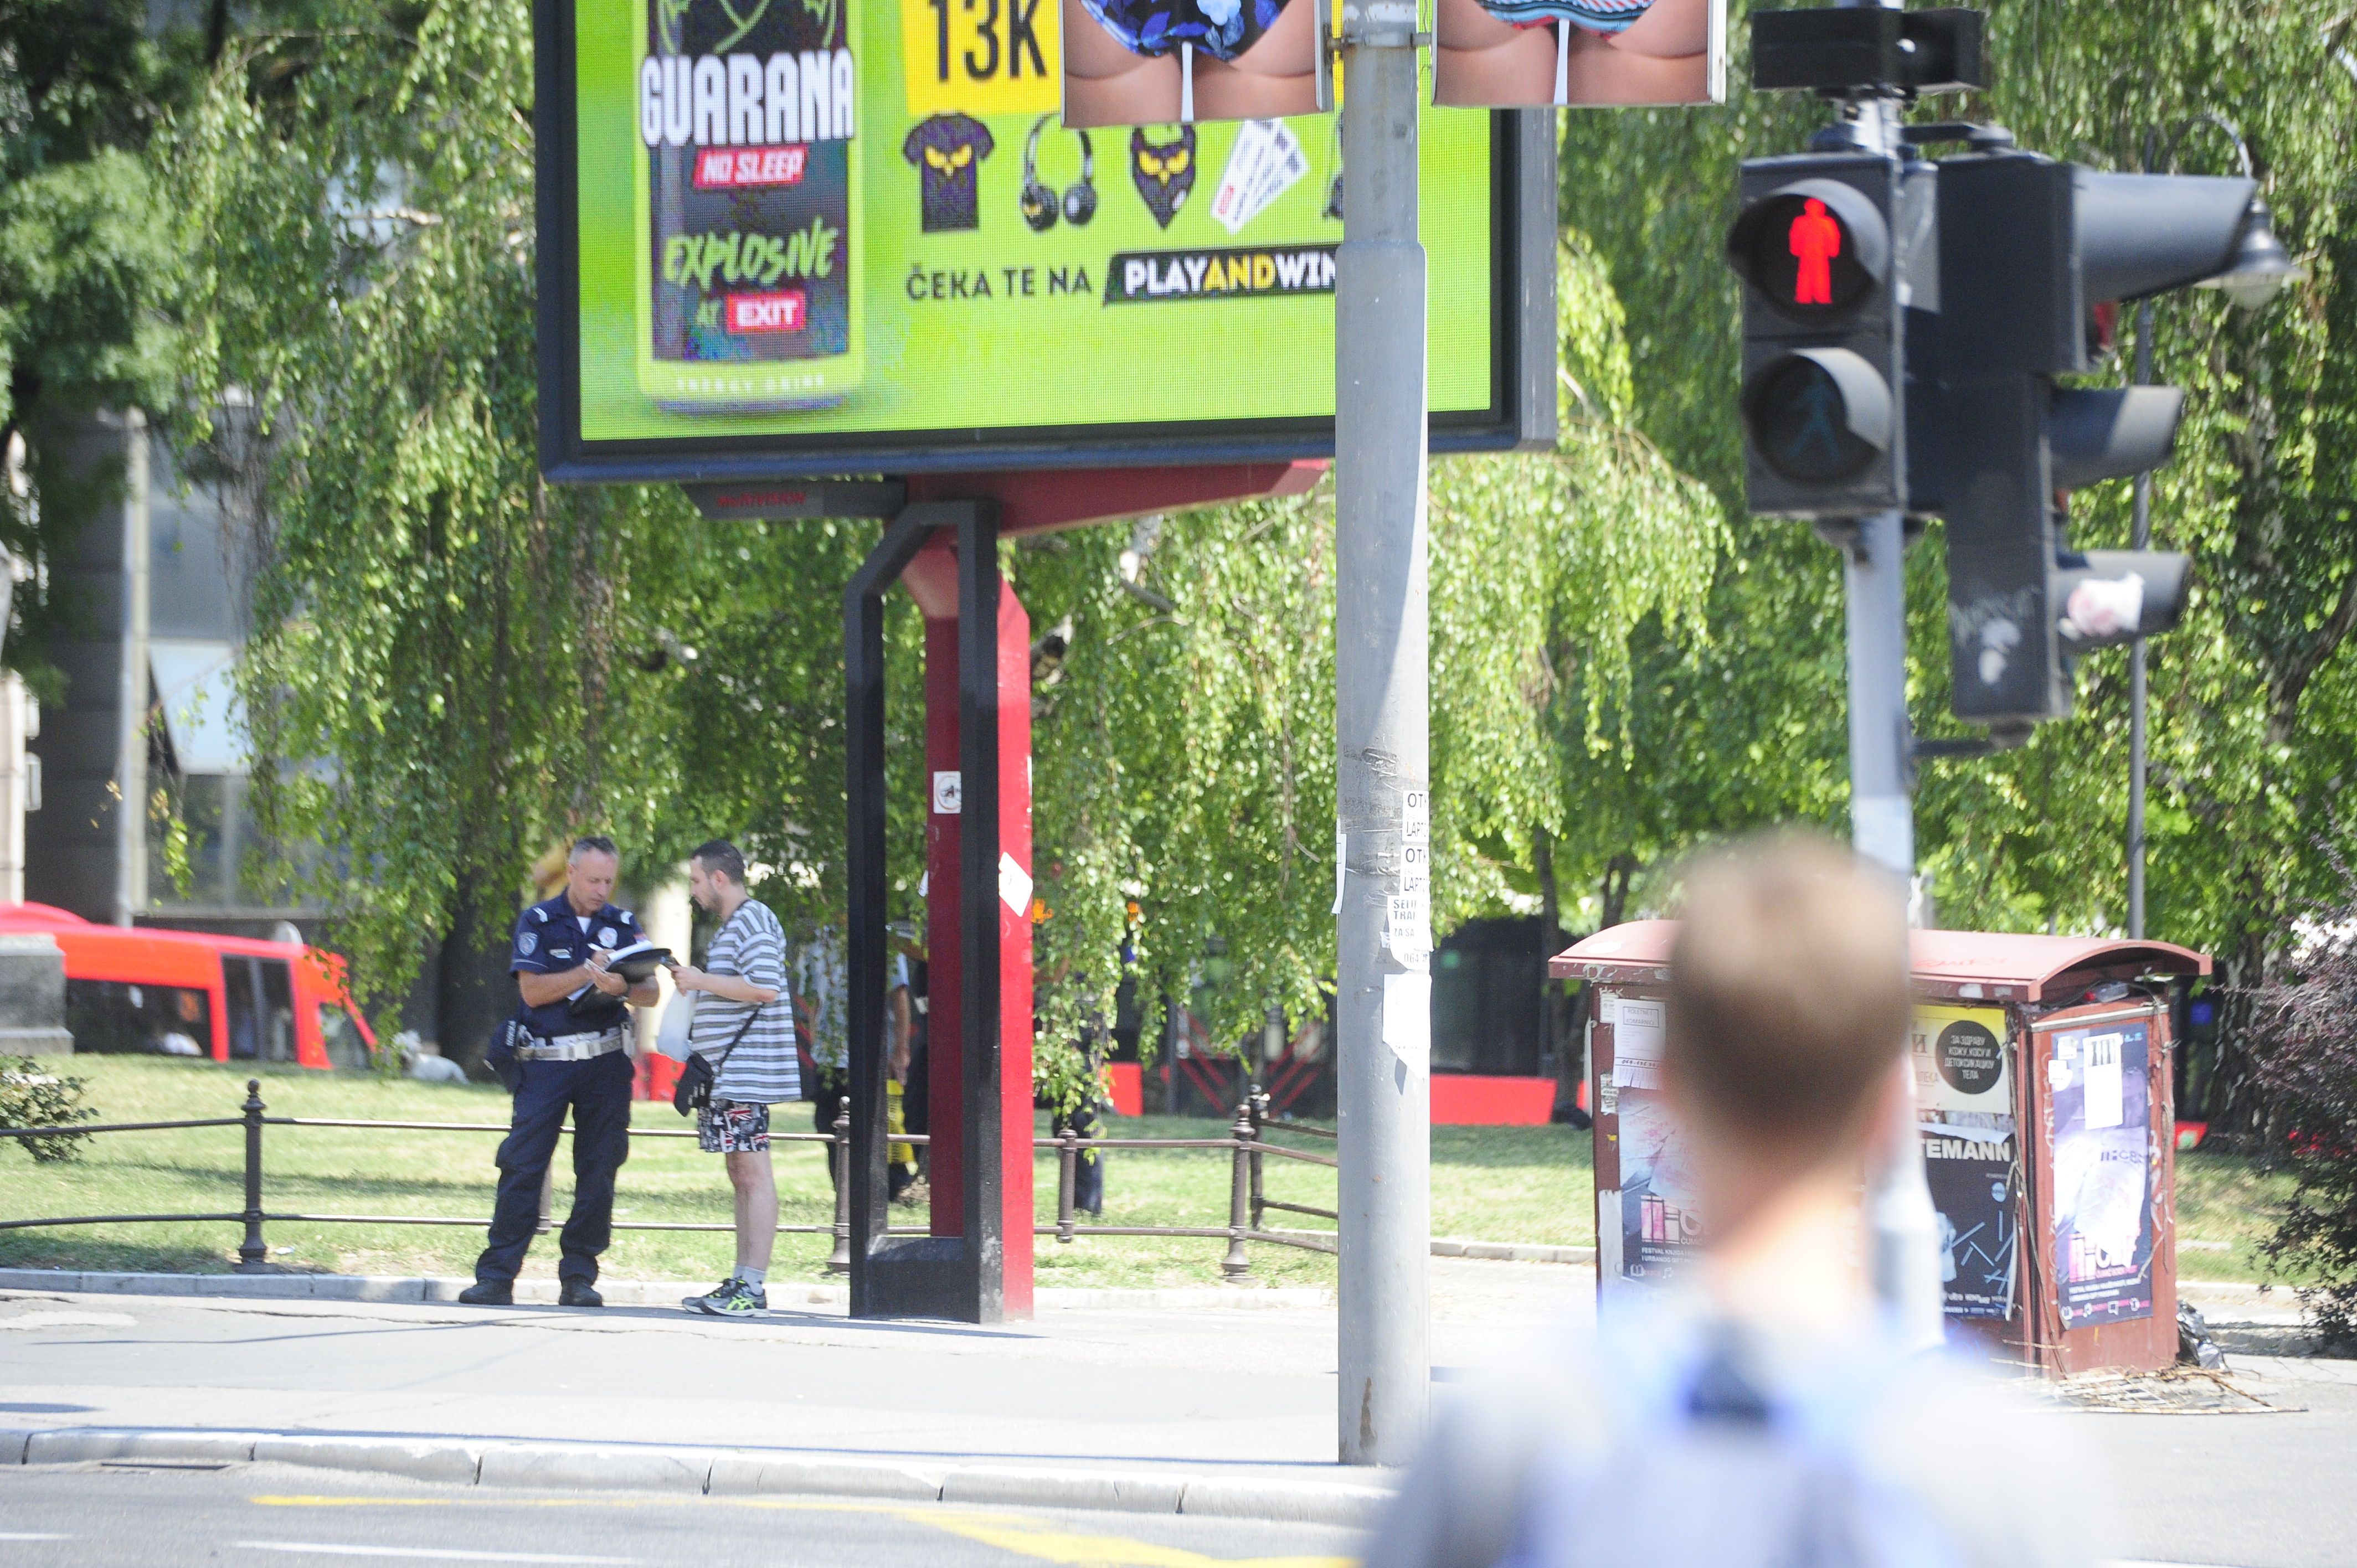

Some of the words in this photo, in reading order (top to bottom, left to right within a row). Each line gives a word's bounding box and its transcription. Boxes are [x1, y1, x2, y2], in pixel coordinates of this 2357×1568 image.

[929, 0, 1047, 82] 13K
[641, 47, 854, 146] GUARANA
[703, 153, 733, 184] NO
[734, 149, 805, 182] SLEEP
[664, 214, 839, 292] EXPLOSIVE
[906, 265, 992, 300] ČEKA
[1002, 265, 1036, 296] TE
[1049, 265, 1092, 295] NA
[736, 298, 797, 327] EXIT
